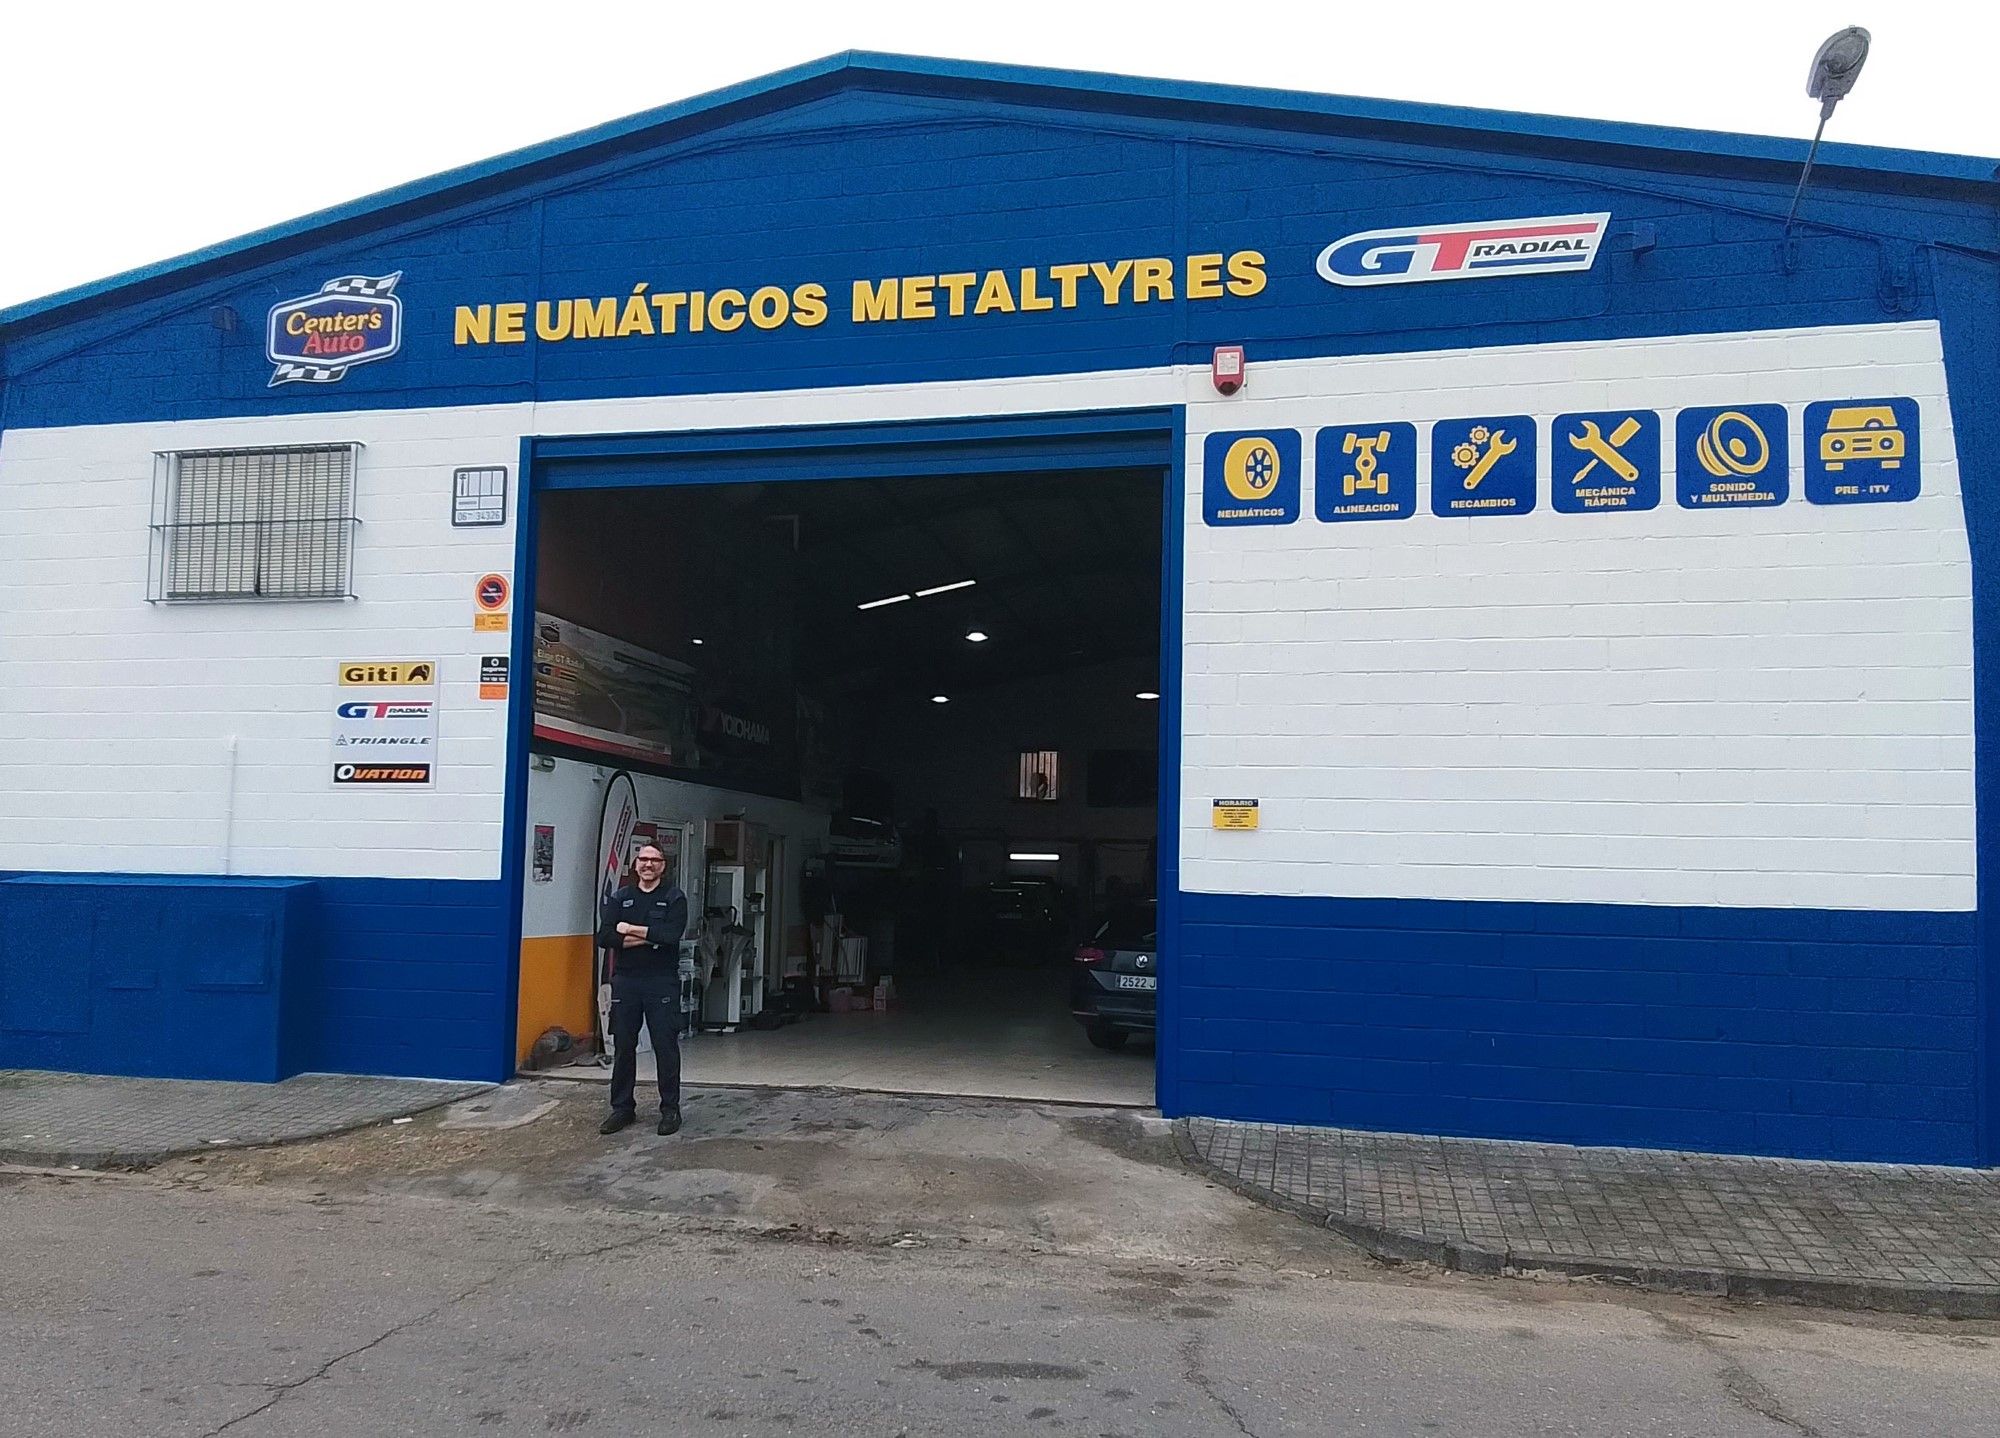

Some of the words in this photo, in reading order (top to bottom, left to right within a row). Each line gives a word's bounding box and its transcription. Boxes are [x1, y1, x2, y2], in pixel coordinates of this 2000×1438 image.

[1473, 239, 1590, 257] RADIAL
[454, 282, 829, 345] NEUMÁTICOS
[851, 250, 1268, 323] METALTYRES
[286, 307, 383, 336] Center's
[302, 330, 366, 355] Auto
[1575, 485, 1636, 497] MECÁNICA
[1710, 482, 1756, 492] SONIDO
[1834, 485, 1859, 495] PRE
[1869, 484, 1890, 494] ITV
[1584, 495, 1627, 507] RÁPIDA
[1690, 494, 1699, 503] Y
[1701, 491, 1776, 503] MULTIMEDIA
[1333, 503, 1399, 514] ALINEACION
[1450, 498, 1516, 509] RECAMBIOS
[1217, 507, 1285, 519] NEUMÁTICOS
[345, 666, 398, 682] Giti
[350, 737, 432, 745] TRIANGLE
[337, 764, 427, 780] OVATION
[1122, 976, 1147, 988] 2522
